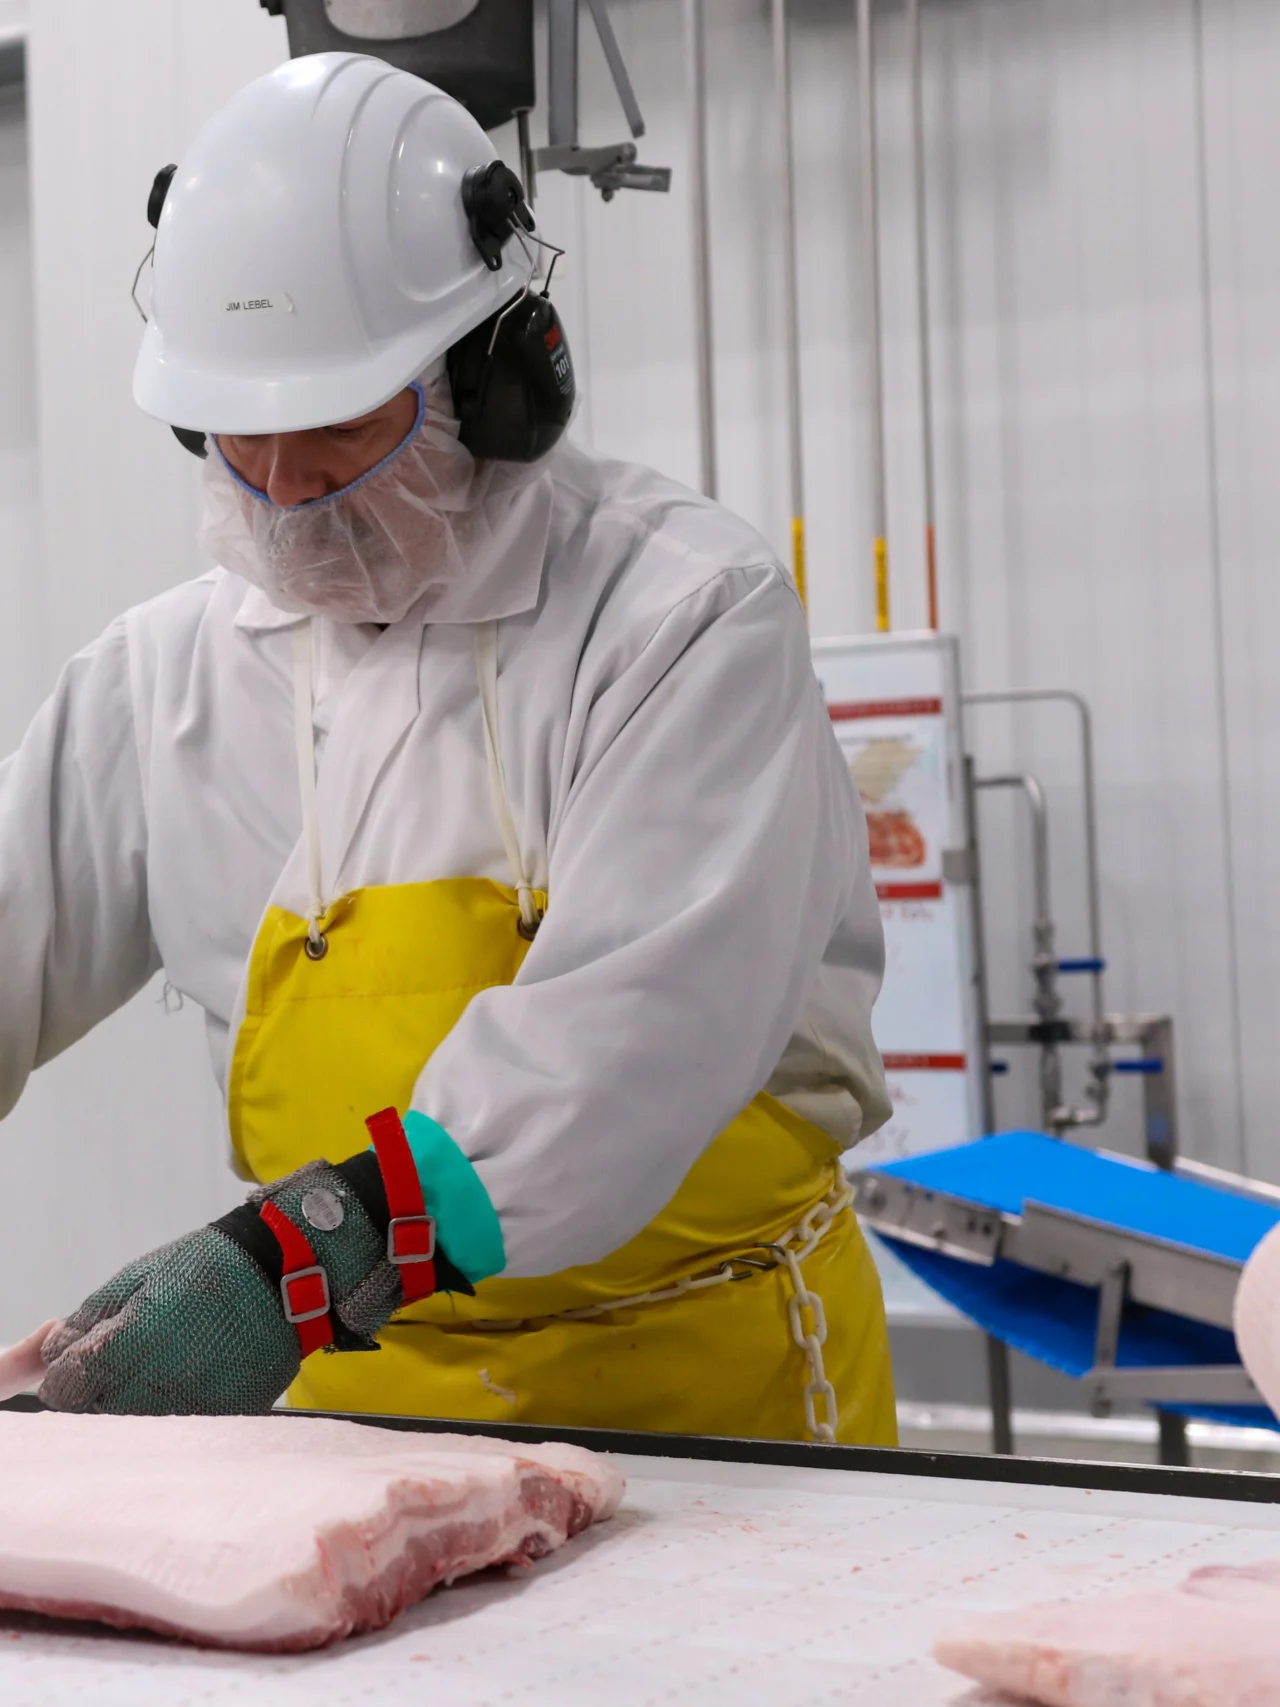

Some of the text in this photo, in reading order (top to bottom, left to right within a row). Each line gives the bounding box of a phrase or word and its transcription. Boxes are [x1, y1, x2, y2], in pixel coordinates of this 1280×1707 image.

[226, 299, 273, 311] JIM LEBEL
[555, 354, 570, 378] 101
